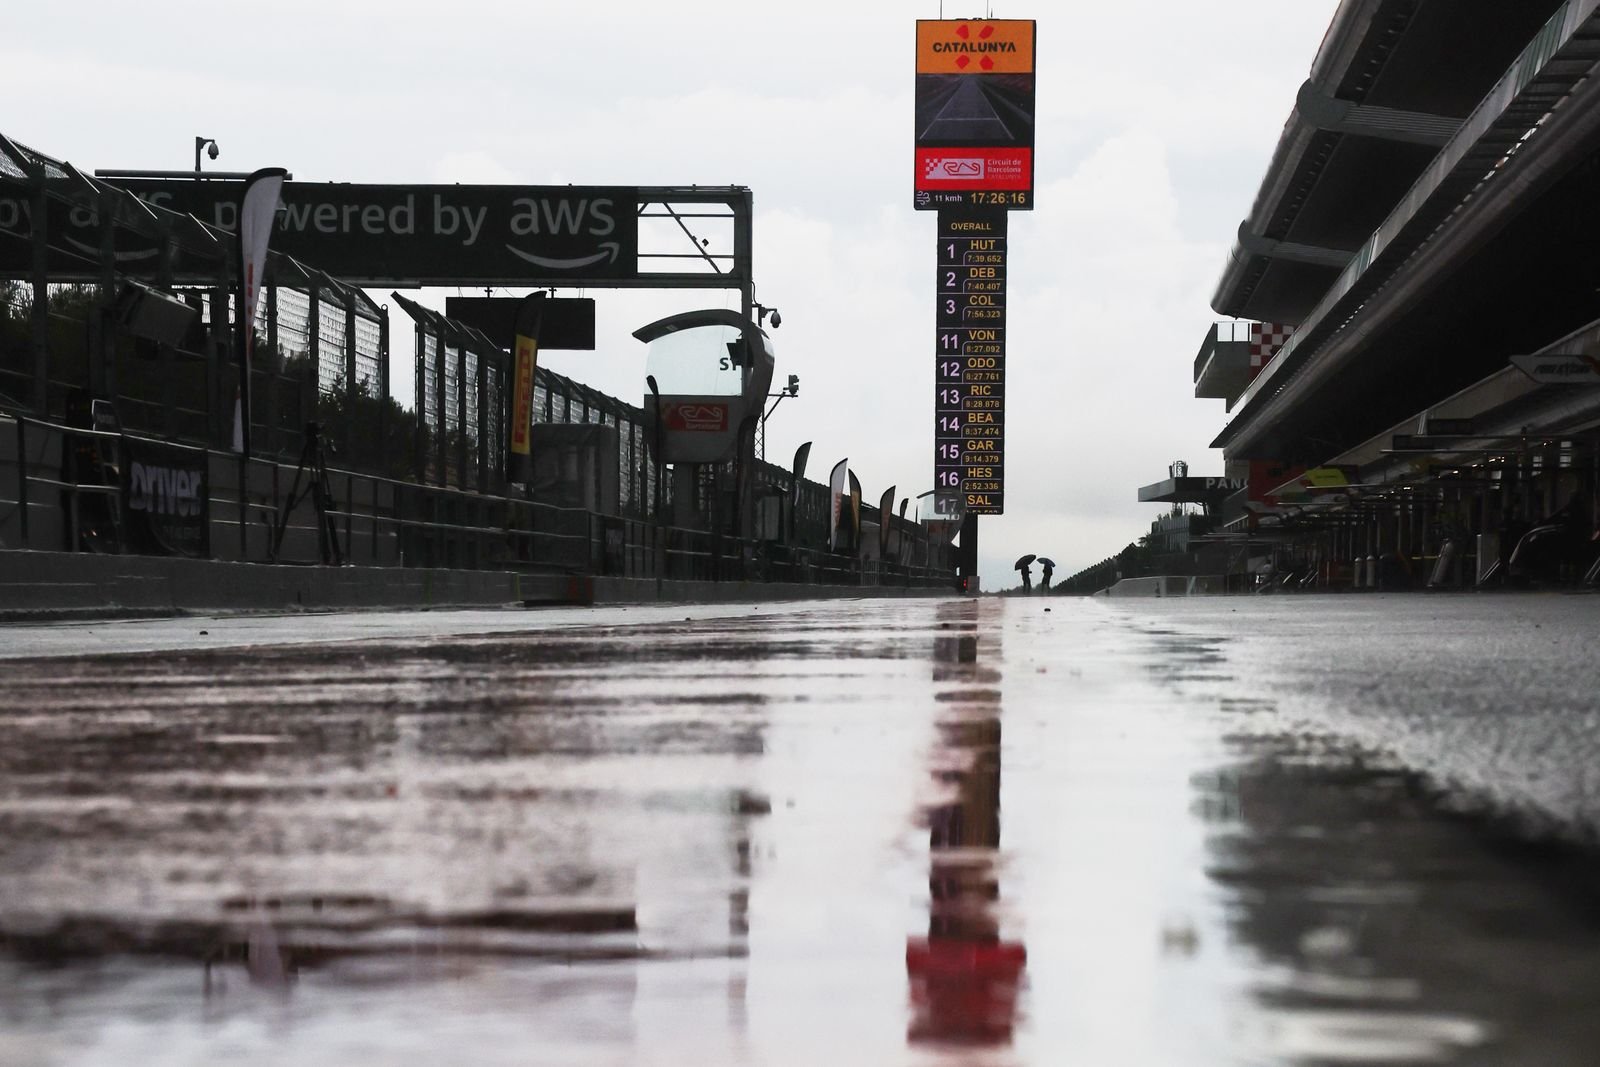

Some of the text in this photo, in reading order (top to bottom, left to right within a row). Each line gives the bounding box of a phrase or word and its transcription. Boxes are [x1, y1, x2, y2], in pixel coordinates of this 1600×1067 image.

[932, 42, 1016, 53] CATALUNYA
[987, 158, 1012, 166] Circuit
[945, 194, 962, 202] kmh
[971, 192, 1025, 204] 17:26:16
[214, 194, 487, 246] pwered by
[510, 197, 615, 236] aws
[971, 240, 995, 250] HUT
[947, 244, 954, 259] 1
[970, 268, 995, 278] DEB
[946, 272, 956, 286] 2
[969, 295, 995, 305] COL
[946, 300, 956, 314] 3
[969, 330, 995, 340] VON
[941, 334, 958, 349] 11
[968, 359, 995, 368] ODO
[940, 362, 960, 377] 12
[971, 386, 991, 395] RIC
[940, 389, 960, 404] 13
[968, 413, 993, 423] BEA
[940, 417, 959, 431] 14
[967, 440, 993, 450] GAR
[939, 444, 959, 459] 15
[968, 468, 992, 478] HES
[939, 472, 959, 486] 16
[967, 495, 991, 505] SAL
